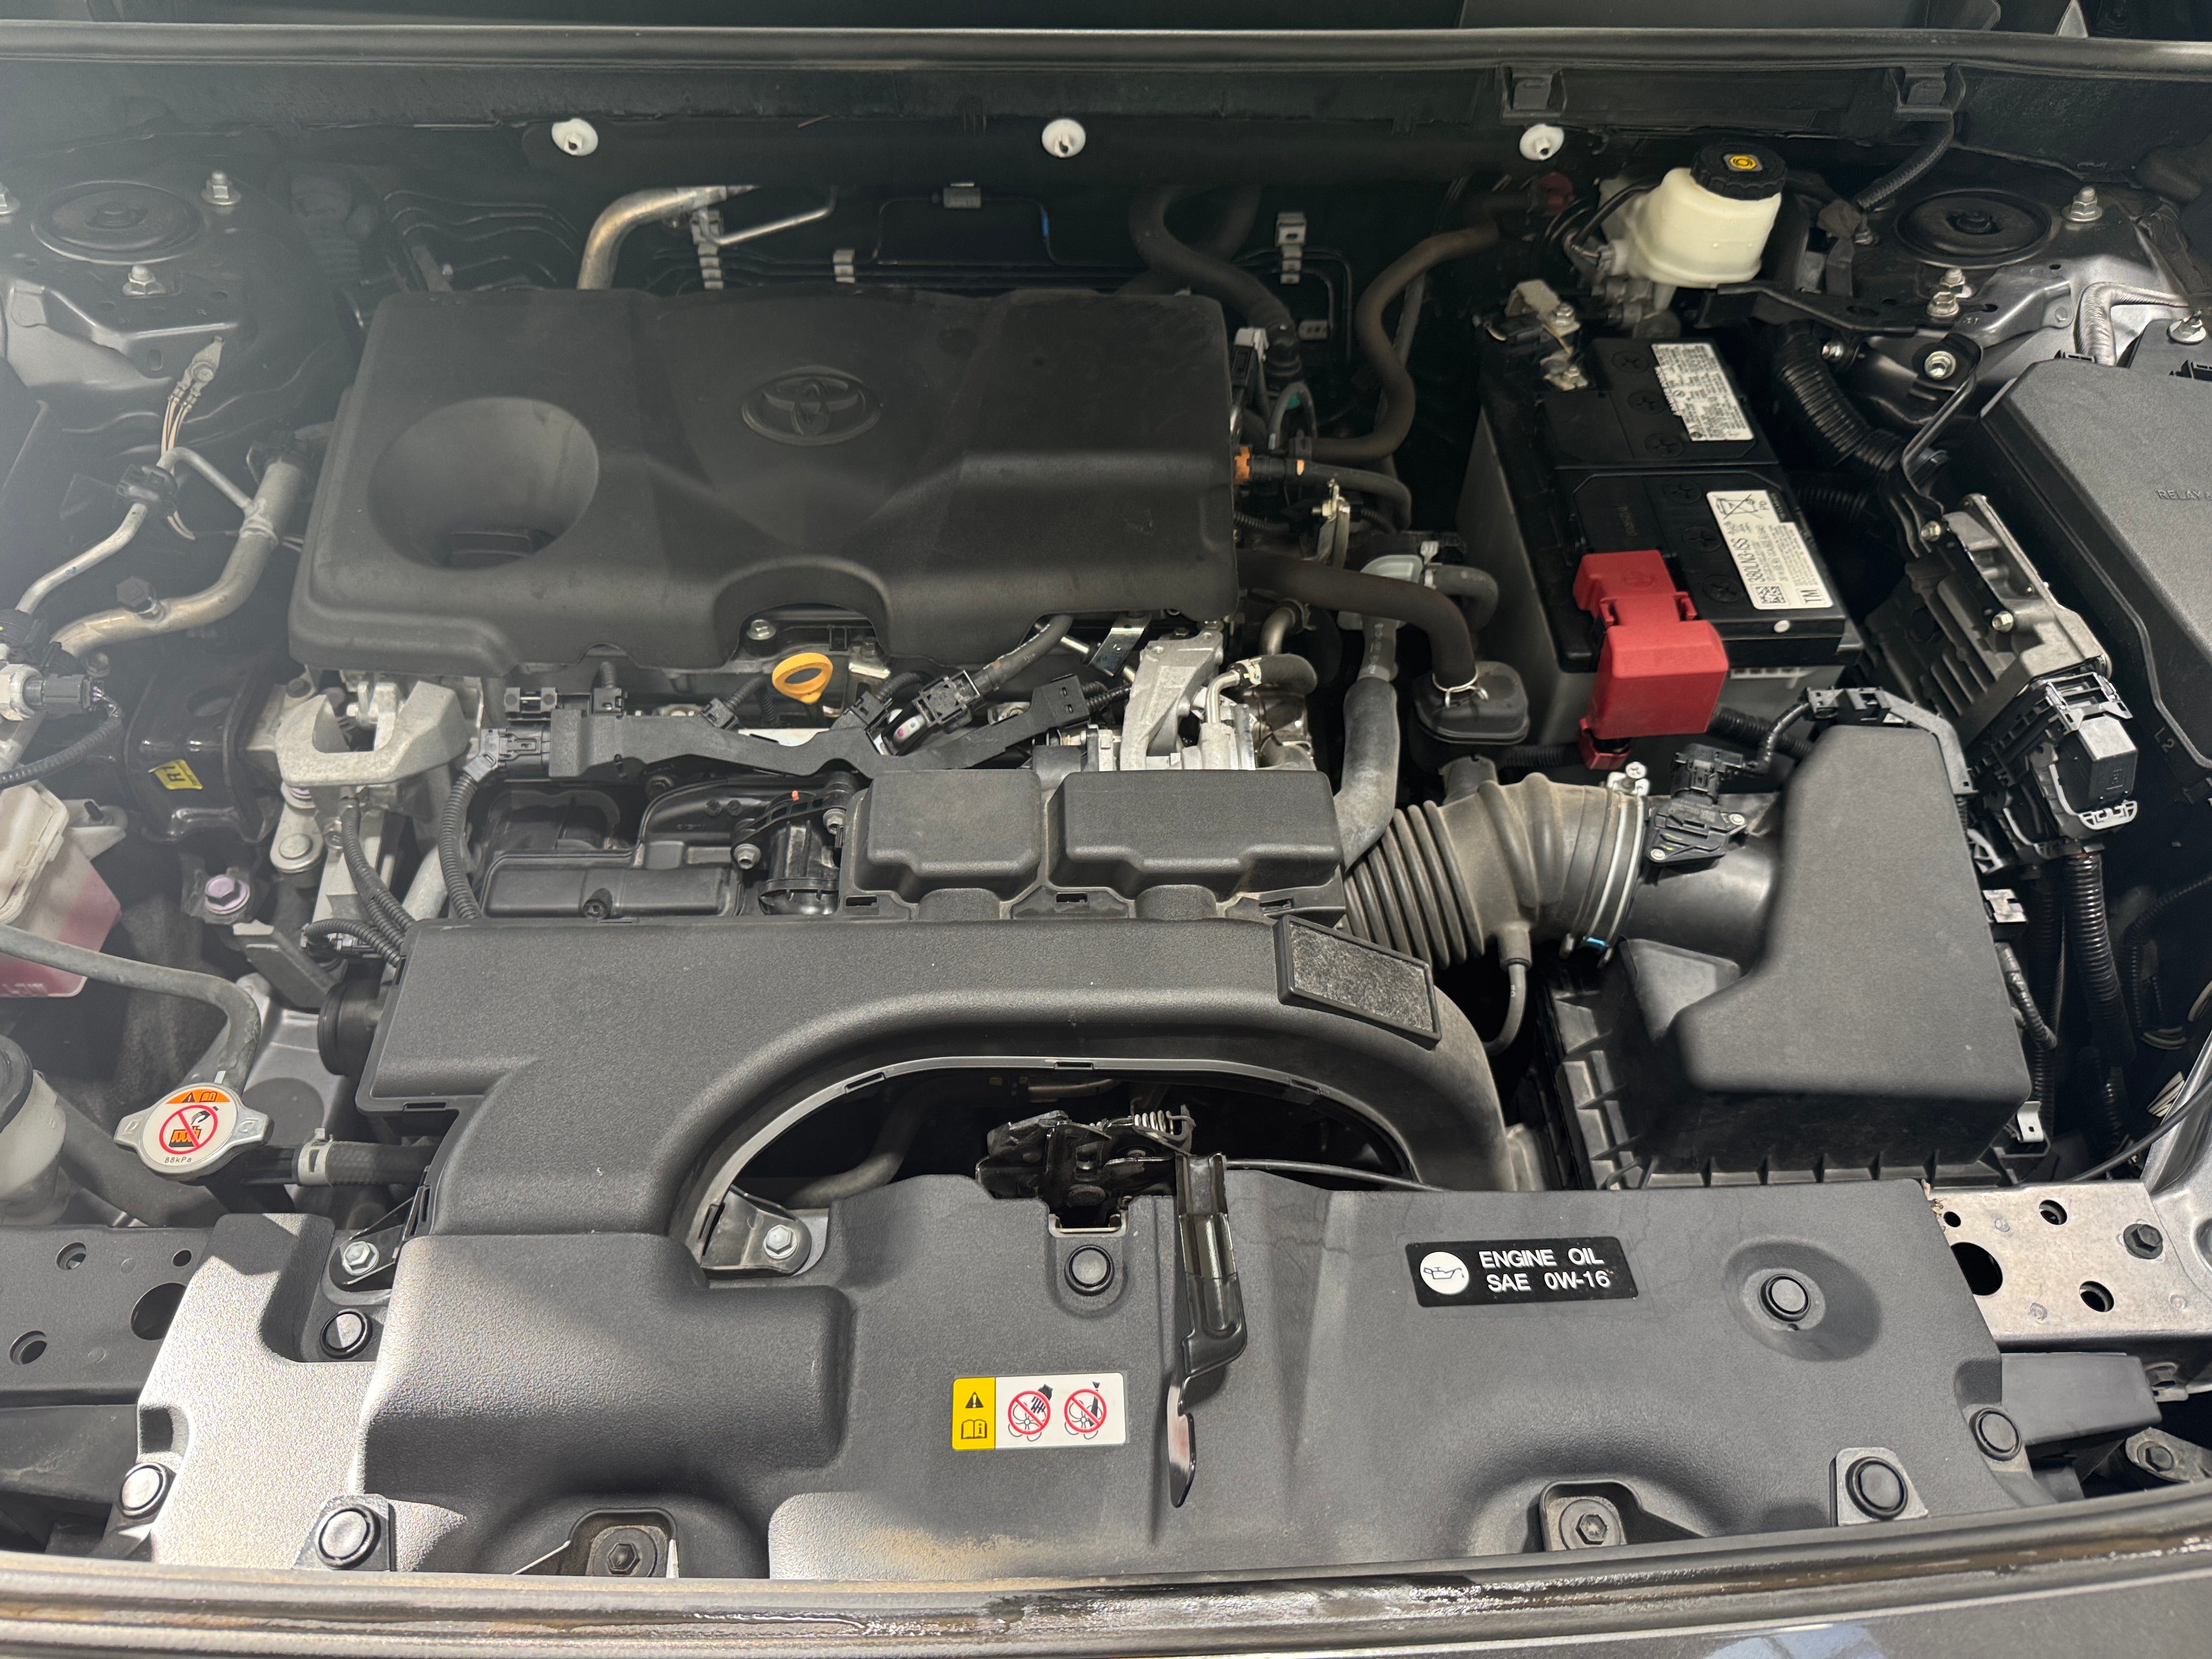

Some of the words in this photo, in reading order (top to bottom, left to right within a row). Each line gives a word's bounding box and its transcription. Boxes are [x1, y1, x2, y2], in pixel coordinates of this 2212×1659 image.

[2157, 489, 2201, 500] RELAY
[1730, 538, 1765, 583] 380LN3-ISS
[1800, 589, 1822, 603] TM
[1478, 1248, 1556, 1269] ENGINE
[1567, 1247, 1605, 1265] OIL
[1486, 1273, 1531, 1293] SAE
[1544, 1269, 1611, 1290] 0W-16
